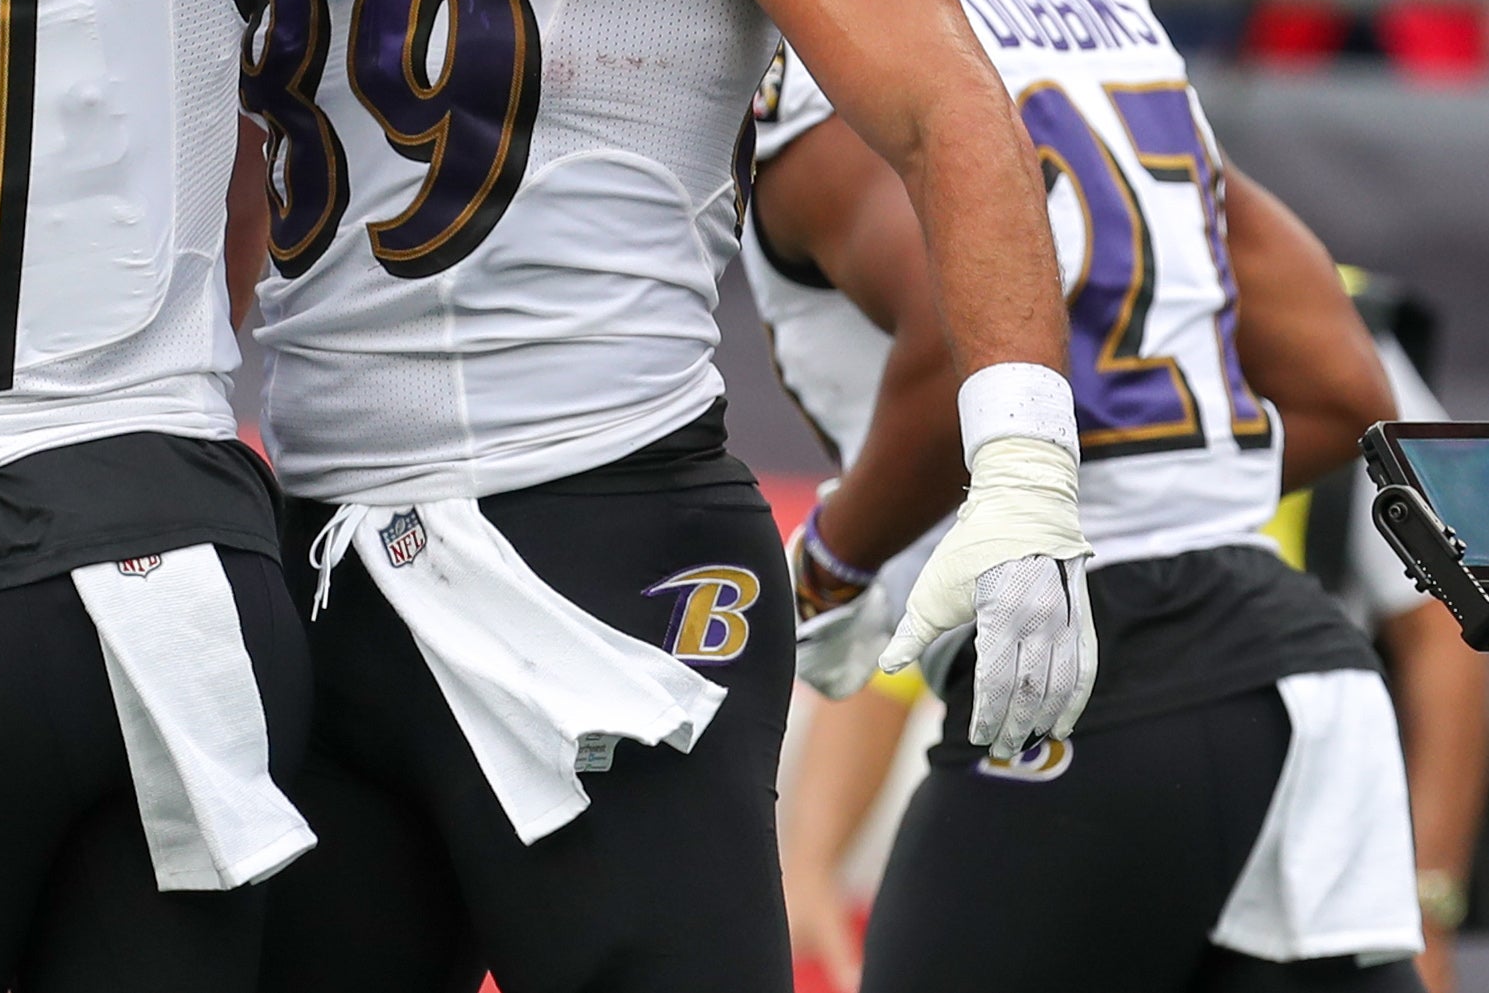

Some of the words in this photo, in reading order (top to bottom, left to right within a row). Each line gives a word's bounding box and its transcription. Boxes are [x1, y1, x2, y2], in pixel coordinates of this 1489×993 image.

[1014, 79, 1274, 461] 27
[388, 529, 425, 565] NFL
[639, 562, 762, 667] B
